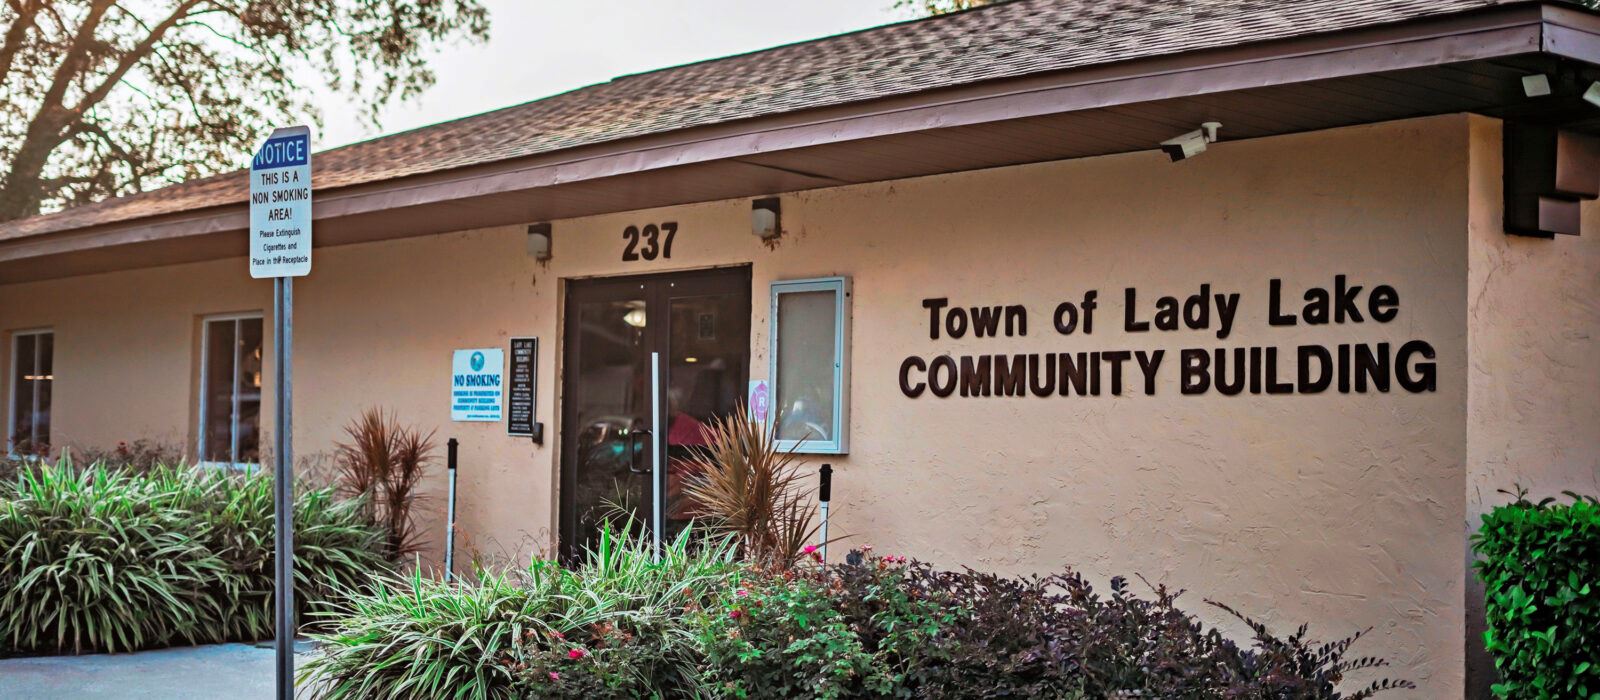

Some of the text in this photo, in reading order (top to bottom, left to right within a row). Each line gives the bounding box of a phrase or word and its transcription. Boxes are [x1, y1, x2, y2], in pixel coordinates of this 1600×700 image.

[256, 140, 304, 166] NOTICE
[262, 170, 299, 186] THIS IS A
[253, 188, 308, 204] NON SMOKING
[269, 208, 292, 221] AREA!
[260, 228, 301, 238] Please Extinguish
[263, 242, 297, 253] Cigarettes and
[622, 221, 678, 262] 237
[253, 258, 265, 266] Place
[283, 255, 308, 265] Receptacle
[922, 274, 1400, 340] Town of Lady Lake
[899, 340, 1437, 398] COMMUNITY BUILDING
[454, 375, 464, 387] NO
[466, 374, 500, 387] SMOKING
[759, 396, 765, 407] R
